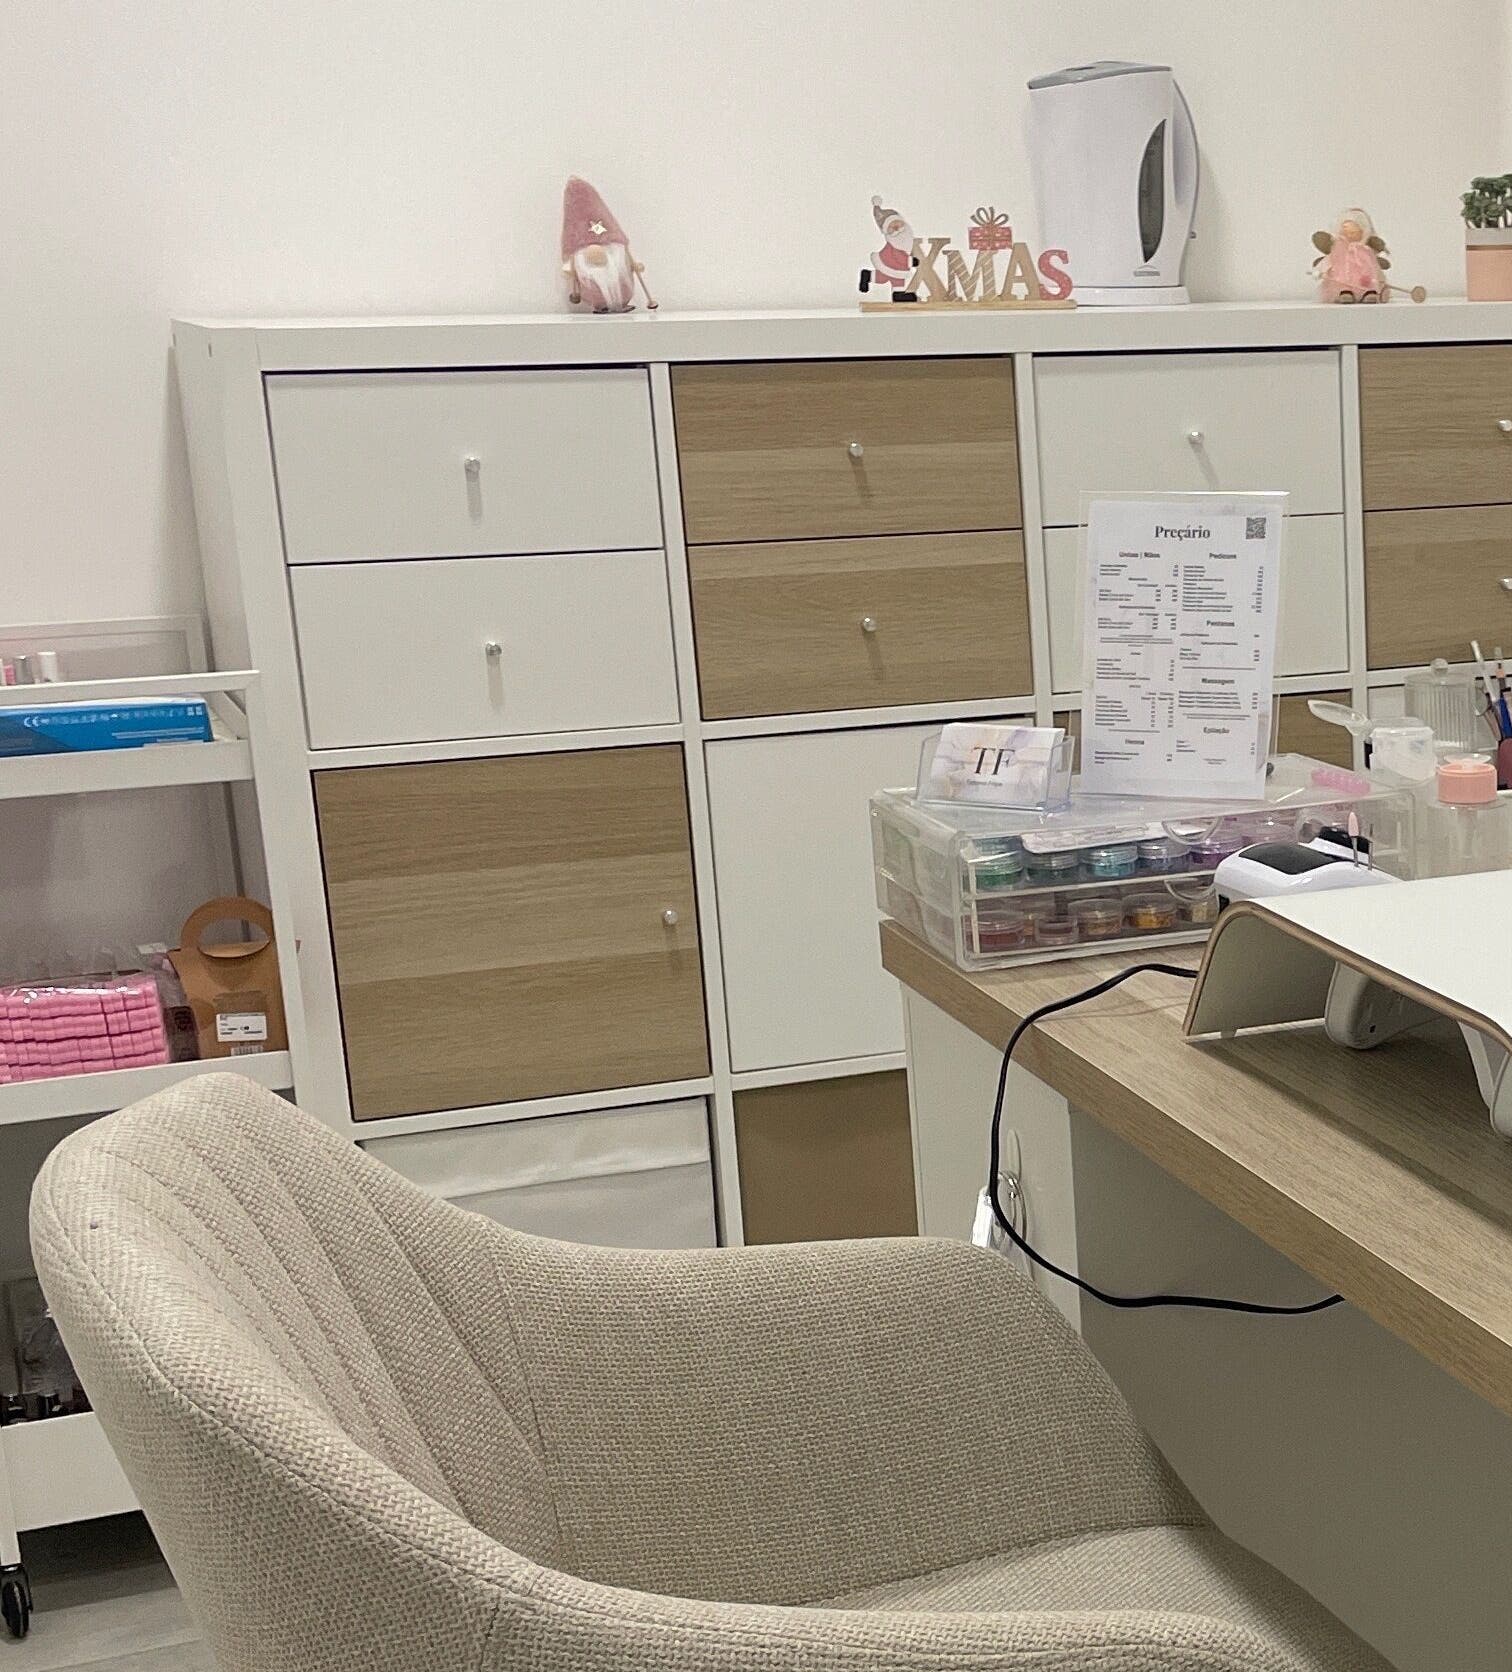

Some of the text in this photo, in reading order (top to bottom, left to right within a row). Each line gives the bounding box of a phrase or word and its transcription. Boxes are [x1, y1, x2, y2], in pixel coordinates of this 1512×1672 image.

[905, 237, 1073, 301] XMAS
[1154, 525, 1211, 541] Preçário
[972, 746, 1016, 776] TF
